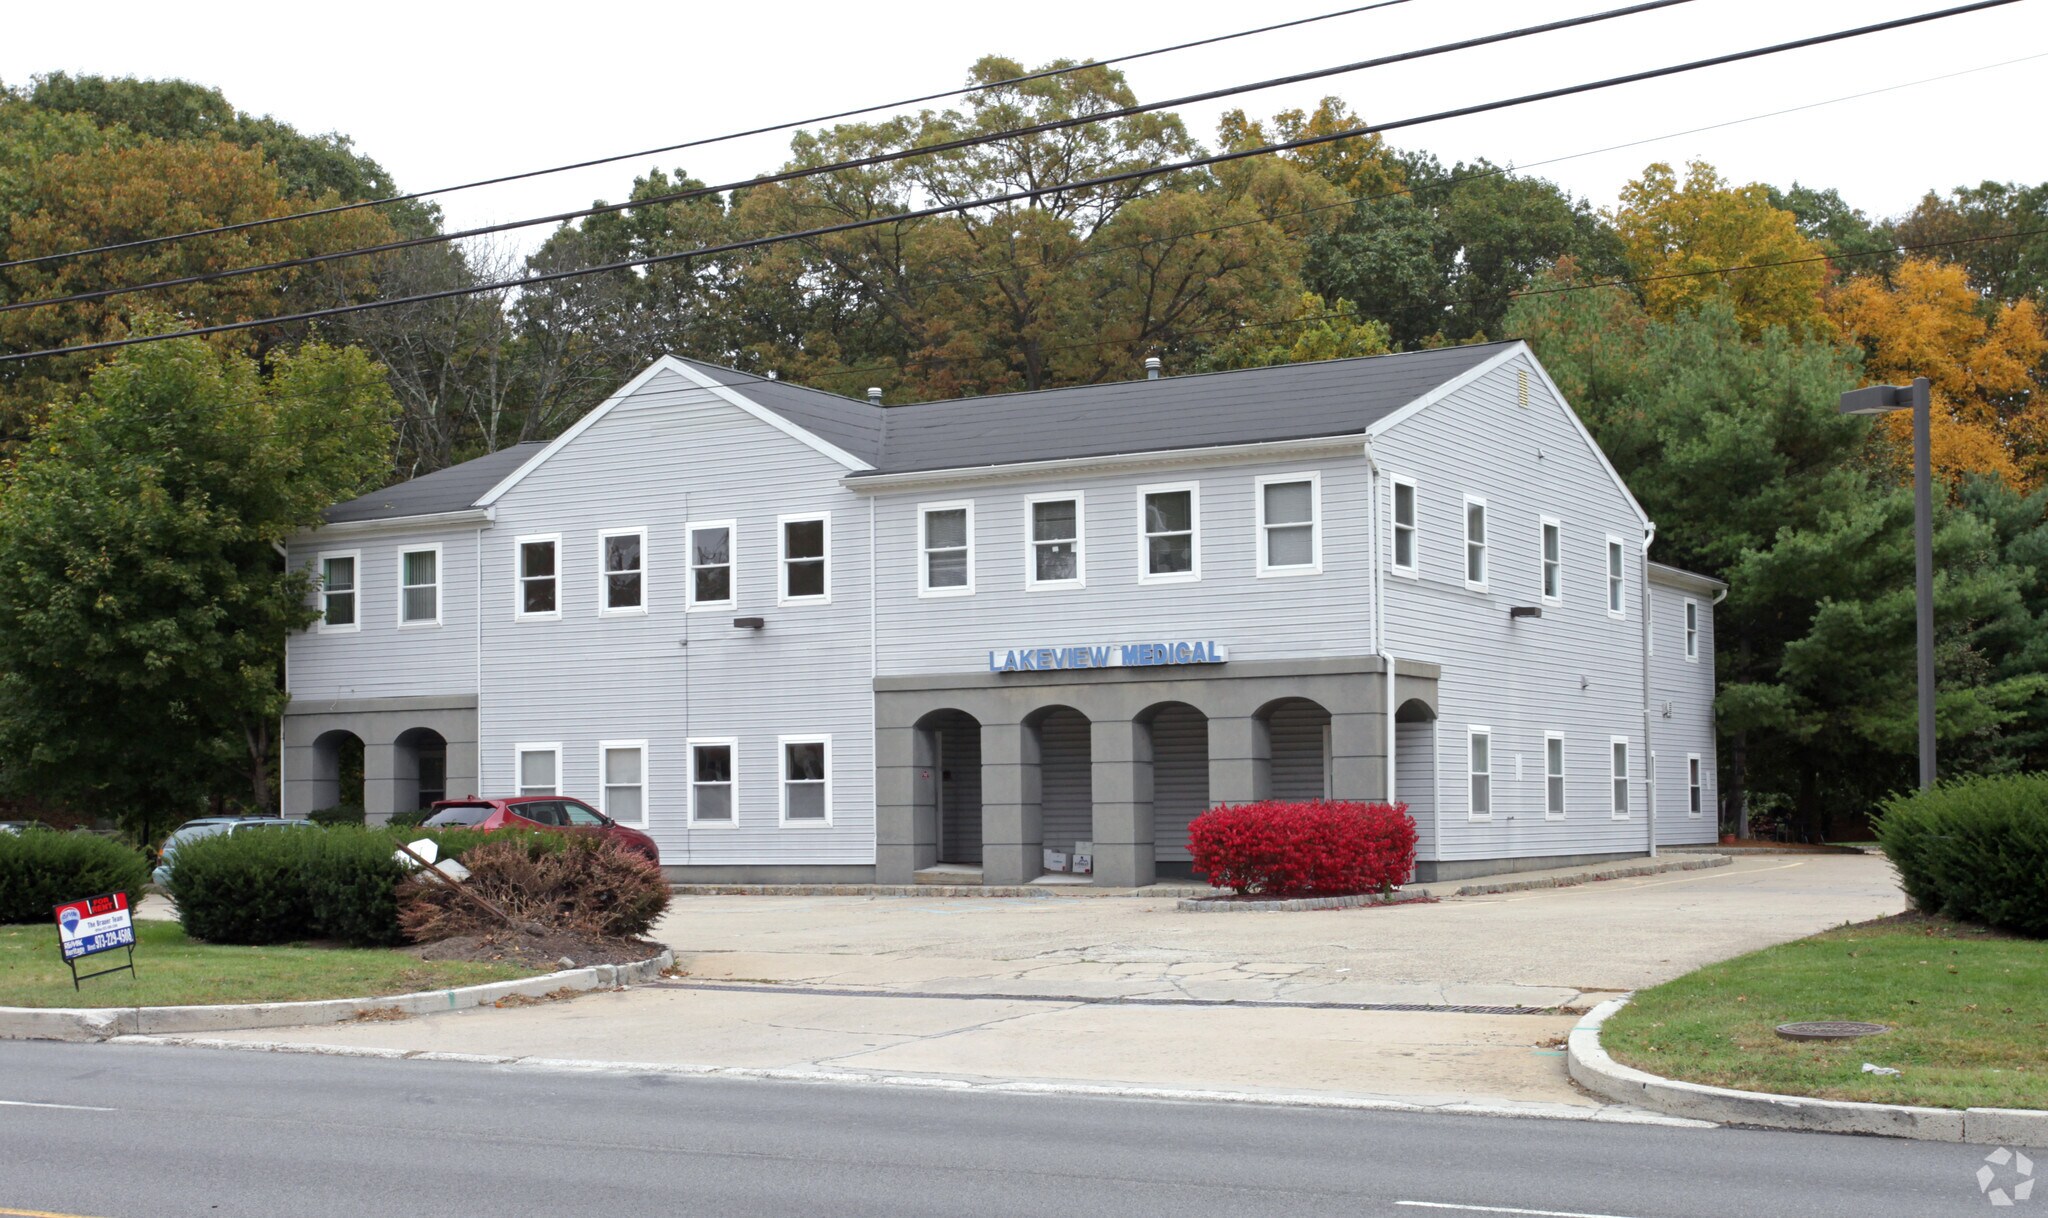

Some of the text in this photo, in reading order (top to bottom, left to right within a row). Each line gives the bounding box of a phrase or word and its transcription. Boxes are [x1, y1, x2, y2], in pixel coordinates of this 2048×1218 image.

[989, 640, 1222, 672] LAKEVIEW MEDICAL
[92, 897, 109, 906] FOR
[91, 902, 113, 914] RENT
